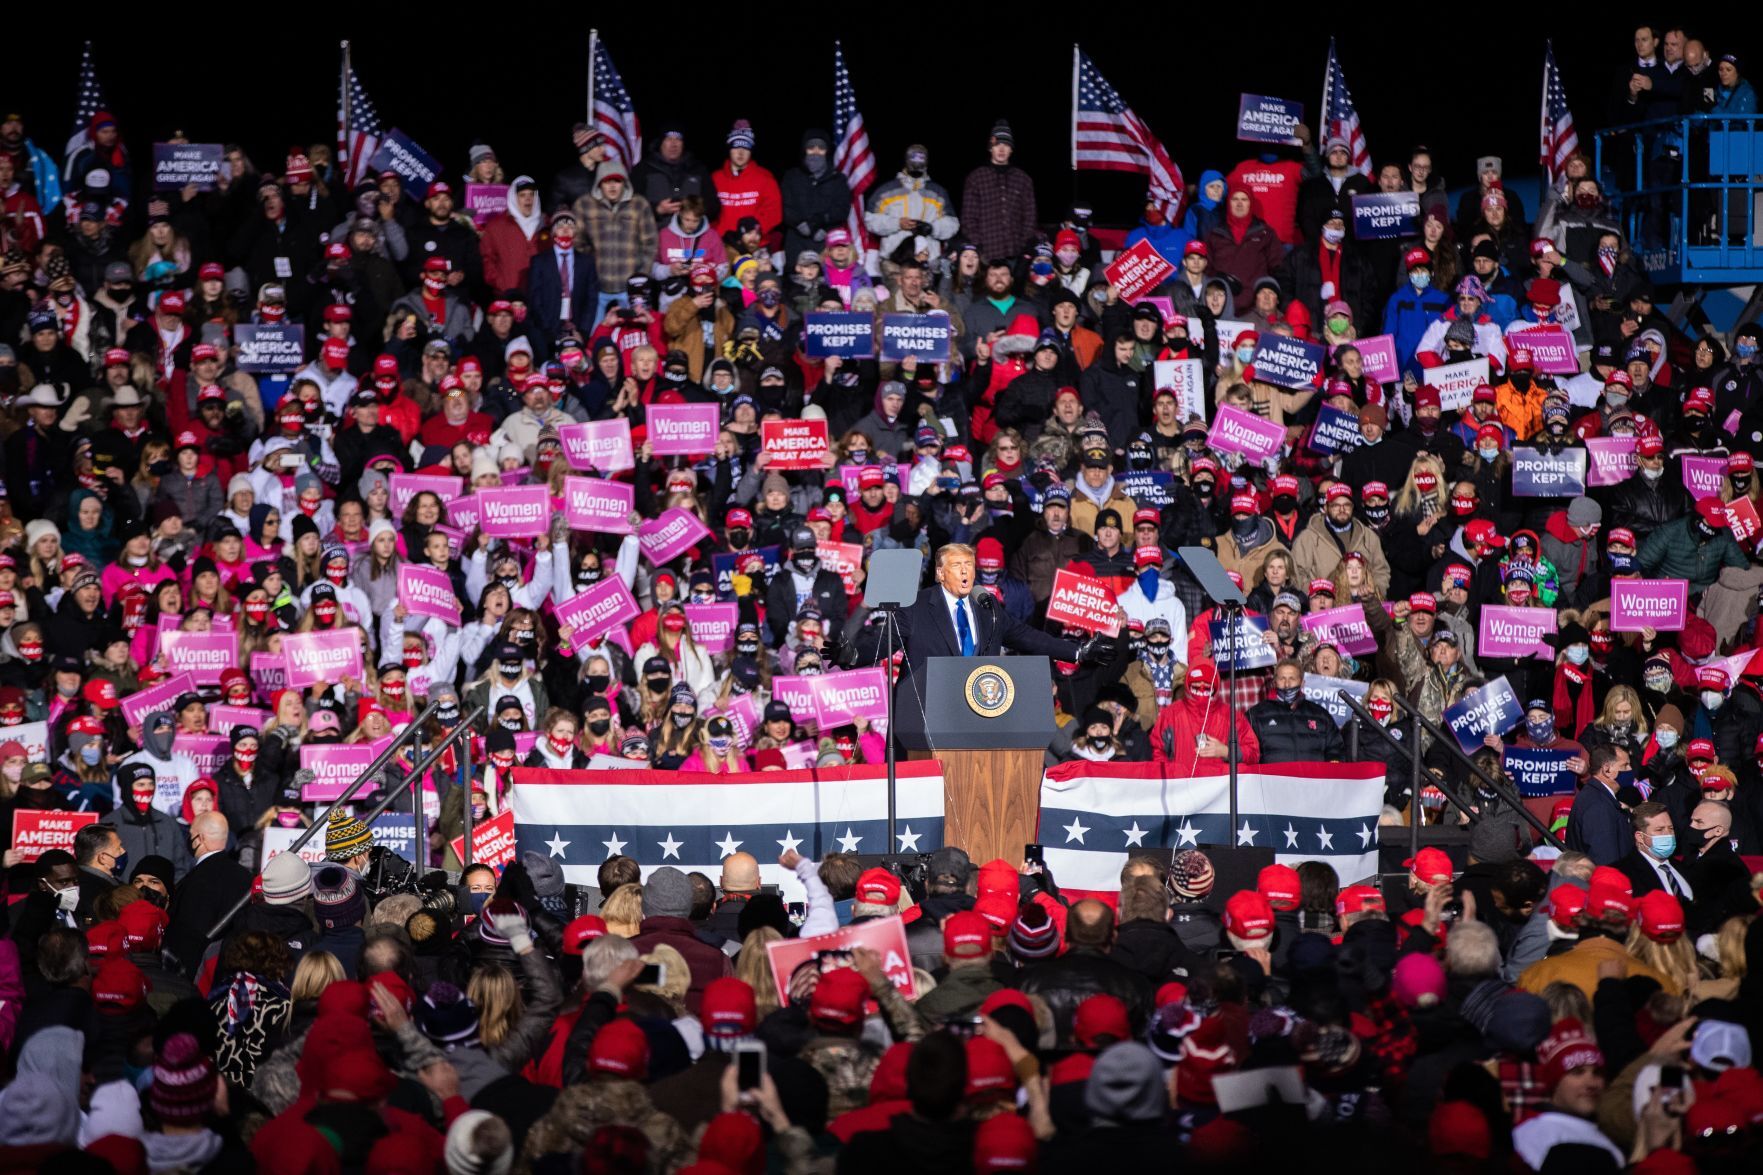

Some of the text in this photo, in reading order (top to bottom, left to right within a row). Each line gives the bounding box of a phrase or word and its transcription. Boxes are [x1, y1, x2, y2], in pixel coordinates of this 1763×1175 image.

[1260, 103, 1286, 113] MAKE
[1244, 111, 1300, 126] AMERICA
[1242, 122, 1294, 135] GREAT AGAI
[157, 161, 218, 172] AMERICA
[384, 139, 435, 183] PROMISES
[389, 157, 418, 182] KEPT
[1242, 174, 1284, 184] TRUMP
[473, 194, 507, 208] Wome
[1356, 204, 1419, 218] PROMISES
[1371, 216, 1401, 227] KEPT
[1114, 254, 1161, 288] AMERICA
[1117, 256, 1140, 274] MAKE
[1121, 262, 1168, 298] GREAT AGAIN
[1564, 315, 1576, 324] AIN
[256, 332, 283, 340] MAKE
[808, 324, 871, 334] PROMISES
[884, 326, 948, 337] PROMISES
[823, 336, 854, 346] KEPT
[898, 338, 934, 349] MADE
[240, 342, 298, 355] AMERICA
[1278, 343, 1305, 354] MAKE
[239, 354, 301, 364] GREAT AGAIN
[1258, 349, 1318, 372] AMERICA
[1362, 350, 1388, 364] men
[1256, 361, 1286, 376] GREAT
[1445, 370, 1470, 380] MAKE
[1438, 376, 1486, 393] MERICA
[1442, 392, 1460, 402] EAT
[656, 419, 710, 434] Women
[784, 427, 809, 436] MAKE
[1335, 418, 1359, 432] MAKE
[1224, 416, 1272, 450] Women
[568, 436, 622, 452] Women
[767, 438, 826, 449] AMERICA
[1224, 432, 1264, 452] FOR TRUMP
[594, 450, 618, 458] TRUMP
[1516, 462, 1581, 473] PROMISES
[1533, 474, 1565, 484] KEPT
[1691, 469, 1723, 484] Wom
[573, 492, 627, 511] Women
[486, 501, 541, 517] Women
[598, 510, 621, 518] TRUMP
[641, 517, 688, 548] Women
[654, 528, 689, 552] FOR TRUMP
[823, 561, 854, 573] RICA
[1077, 582, 1105, 597] MAKE
[412, 594, 453, 609] FOR TRUMP
[1057, 588, 1120, 614] AMERICA
[1621, 595, 1676, 610] Women
[567, 593, 623, 628] Women
[1053, 601, 1118, 626] GREAT AGAIN
[579, 606, 622, 633] FOR TRUMP
[693, 621, 730, 634] omen
[1314, 622, 1368, 640] Women
[1490, 620, 1544, 636] Women
[1591, 635, 1612, 643] MAG
[172, 647, 230, 663] Women
[292, 648, 352, 664] Women
[198, 662, 224, 670] TRUMP
[320, 662, 347, 670] TRUMP
[820, 686, 879, 706] Women
[829, 699, 876, 711] FOR TRUMP
[1451, 691, 1512, 732] PROMISES
[1470, 709, 1506, 736] MADE
[1506, 758, 1567, 770] PROMISE
[1523, 772, 1557, 783] KEPT
[39, 820, 72, 830] MAKE
[374, 826, 418, 838] OMISE
[474, 828, 500, 846] MAKE
